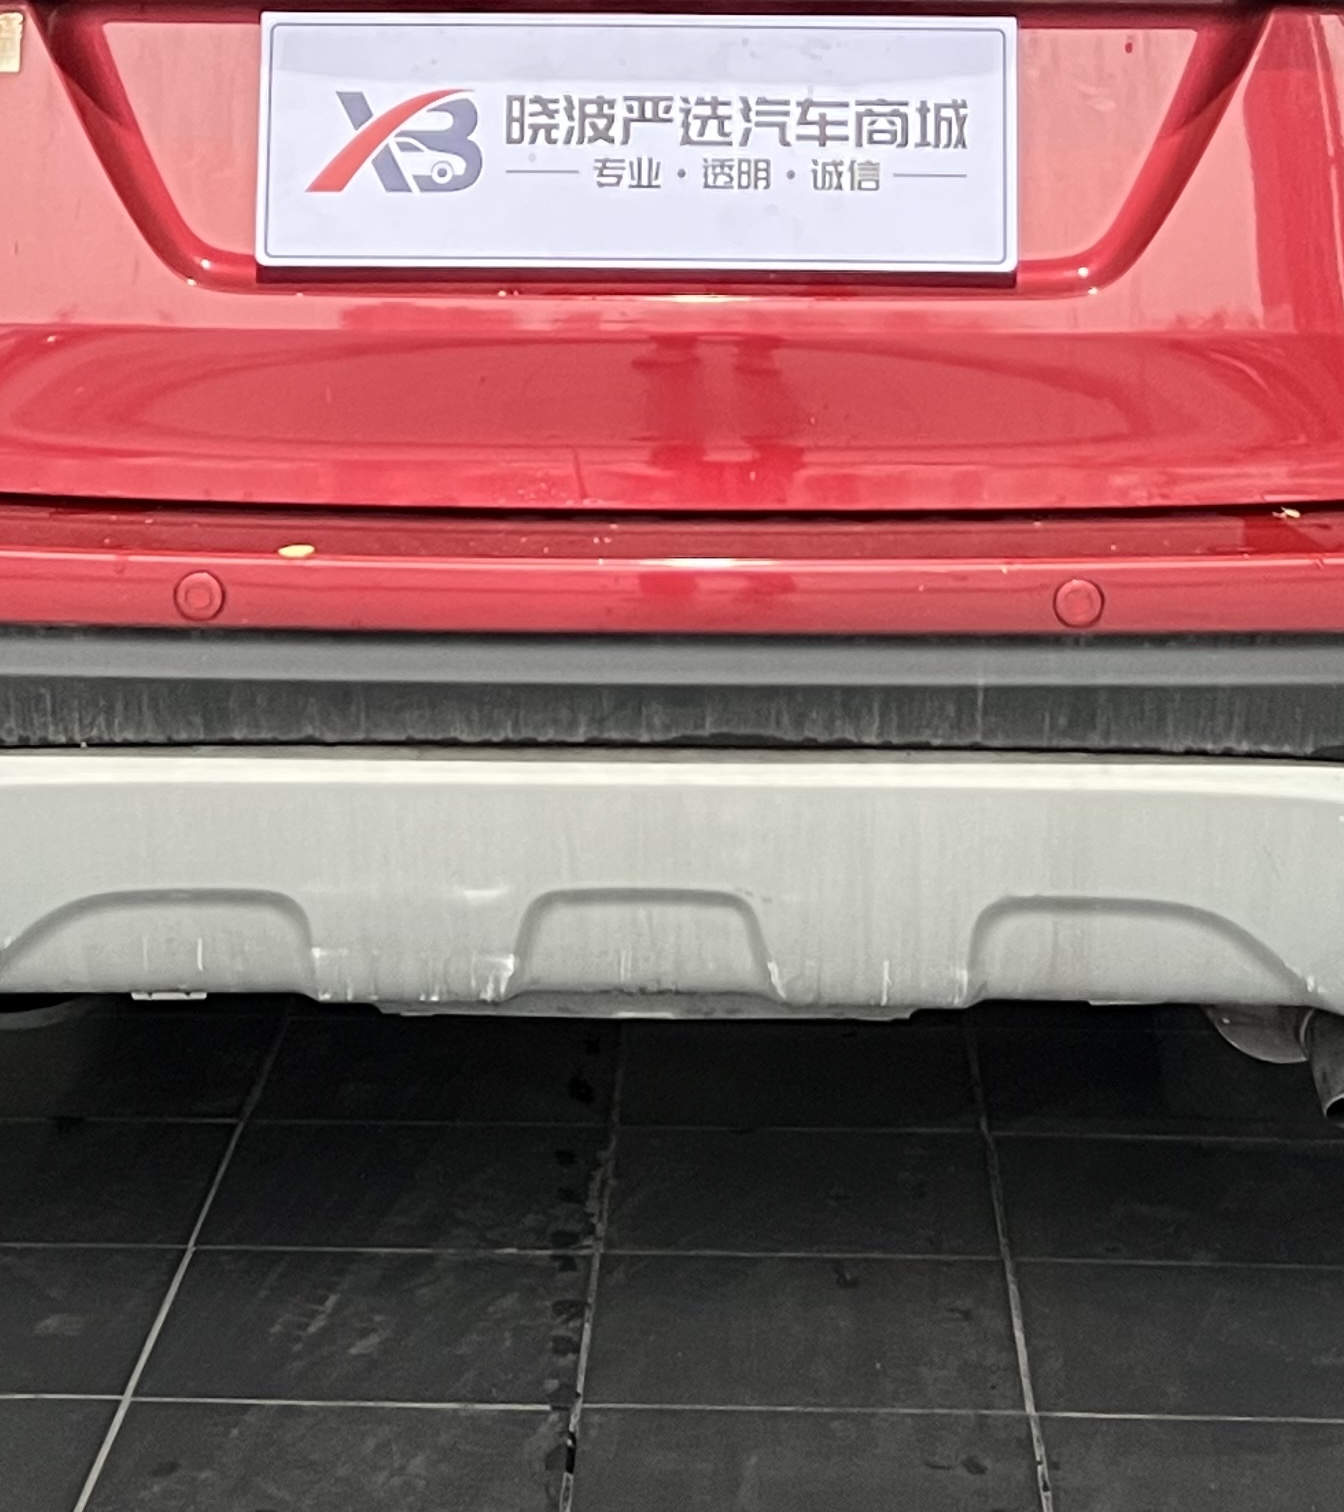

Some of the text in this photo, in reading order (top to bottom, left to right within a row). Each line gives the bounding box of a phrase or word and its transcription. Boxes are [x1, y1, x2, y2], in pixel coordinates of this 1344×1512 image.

[505, 94, 969, 150] 晓波严选汽车商城
